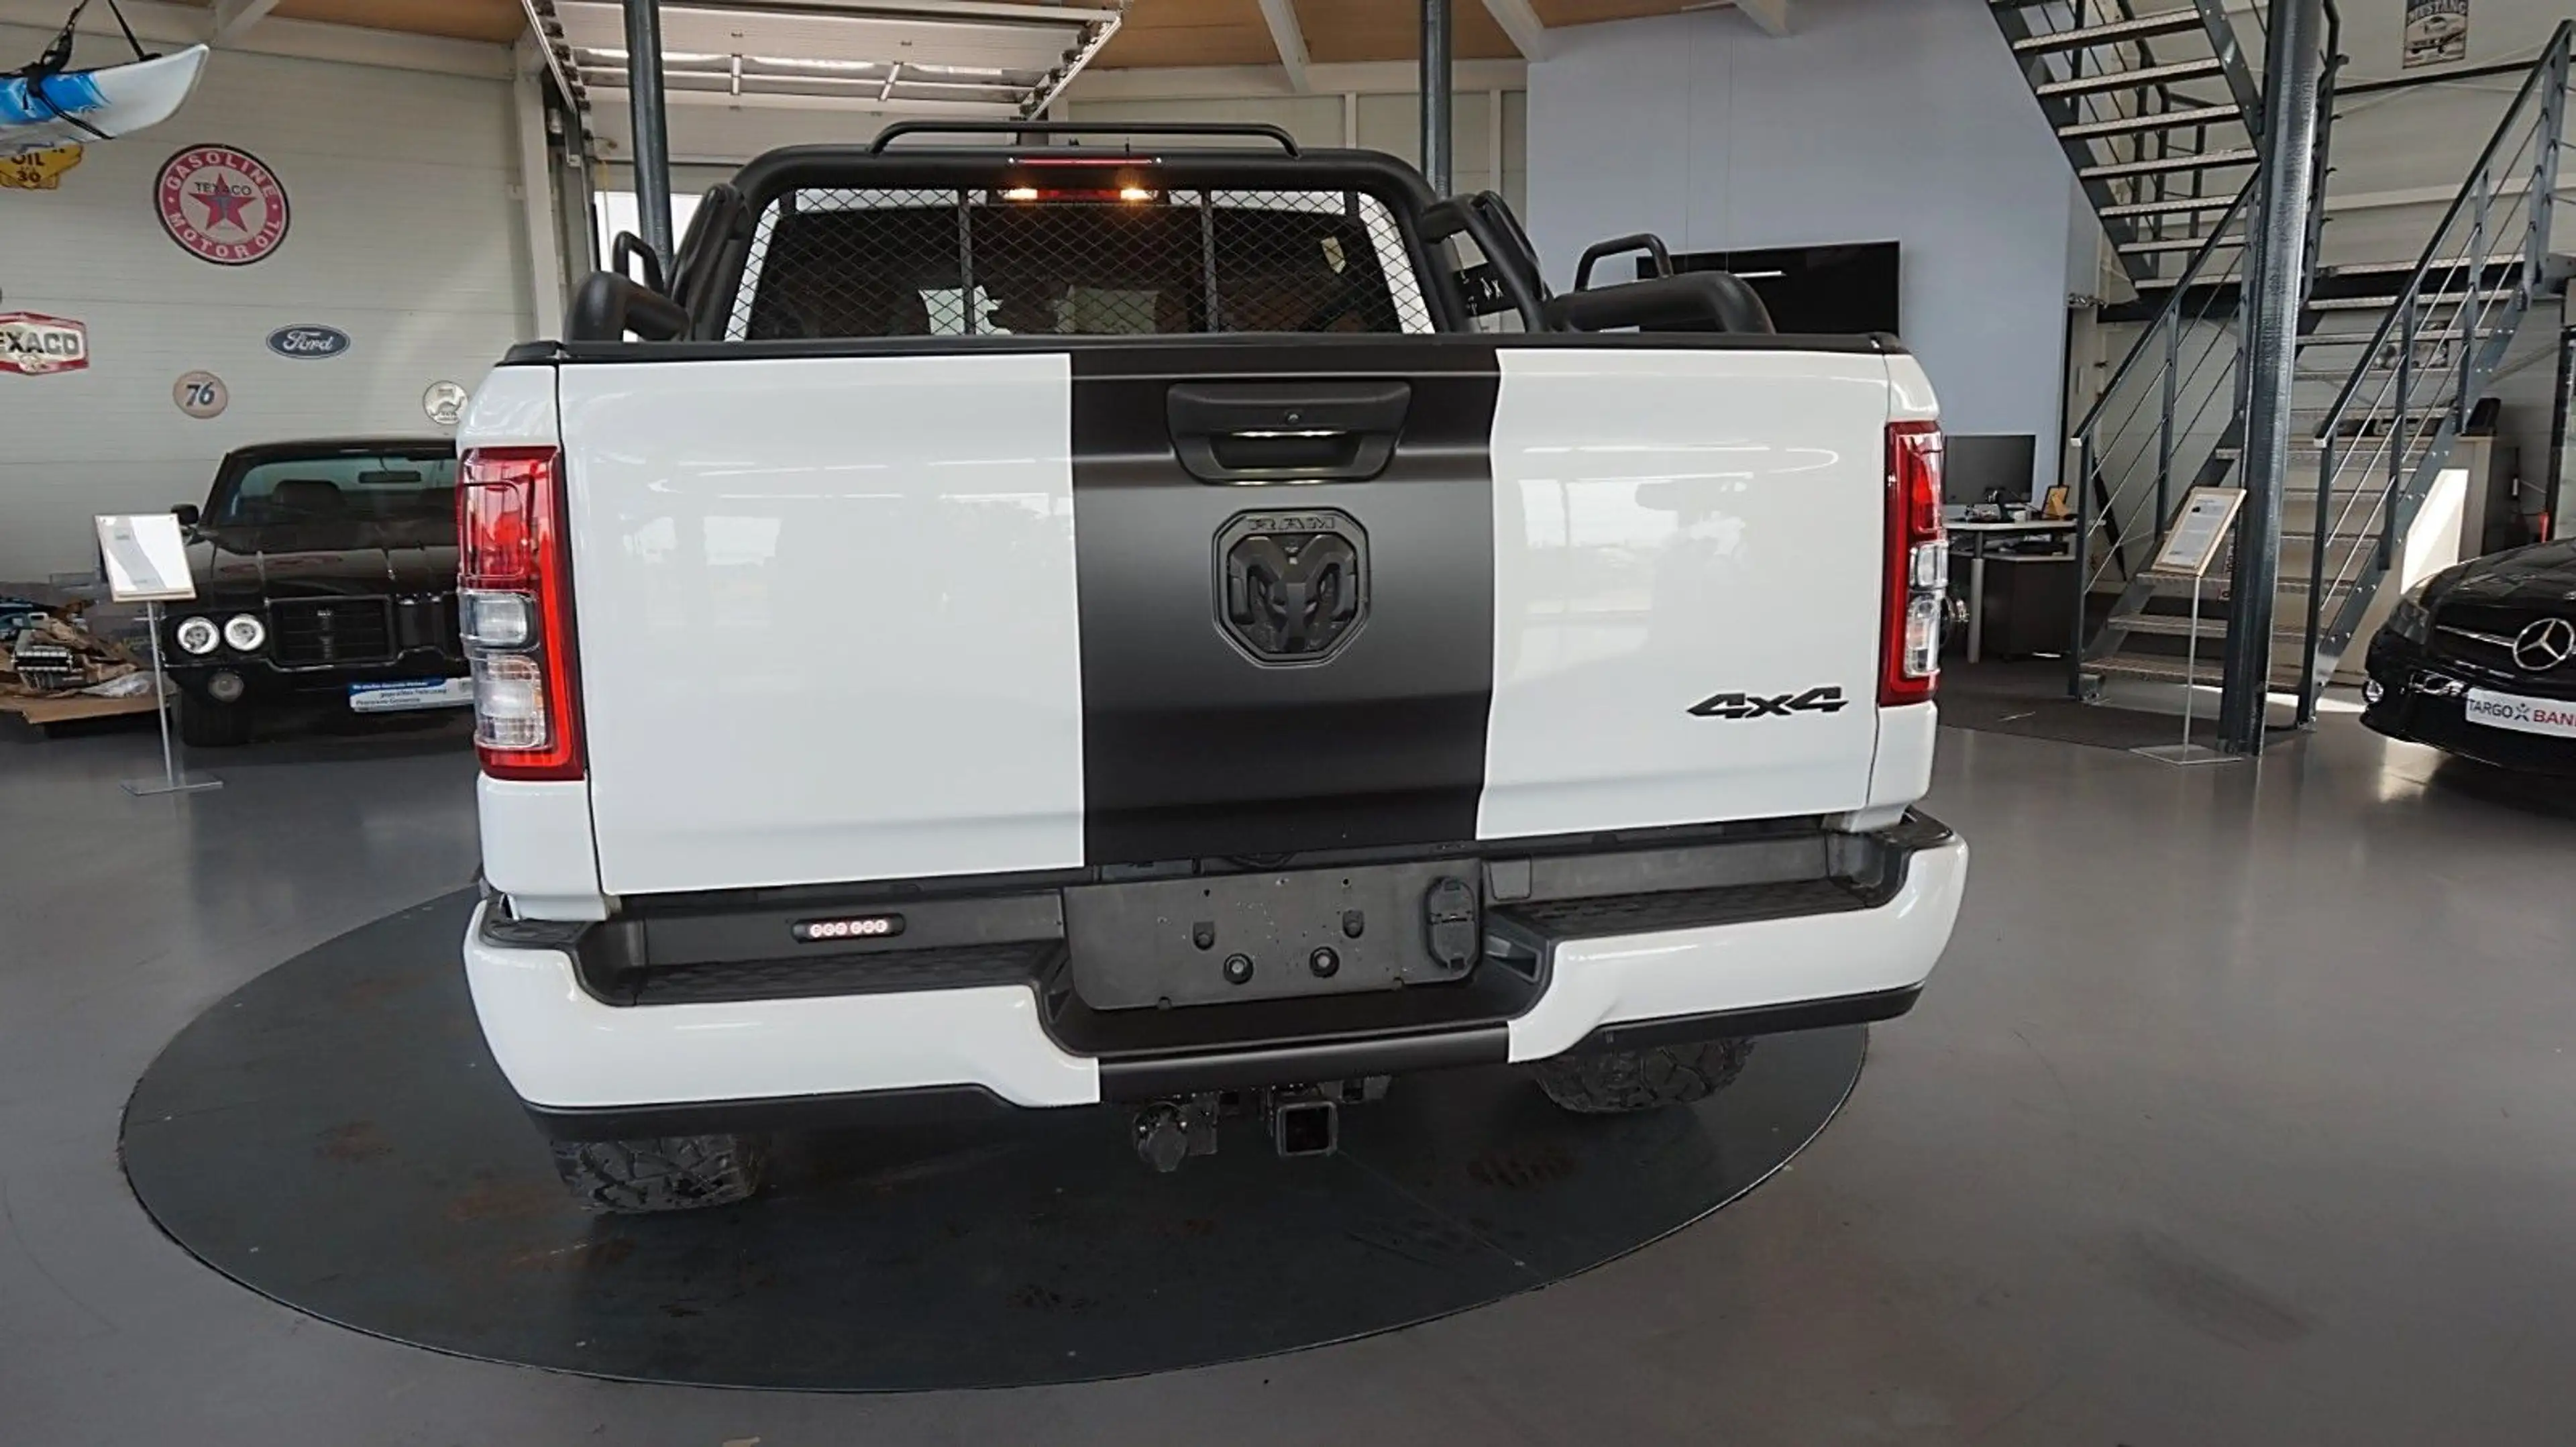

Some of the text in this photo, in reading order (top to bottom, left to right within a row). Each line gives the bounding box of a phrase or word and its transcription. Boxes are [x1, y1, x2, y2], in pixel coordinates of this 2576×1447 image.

[166, 152, 278, 197] GASOLINE
[169, 213, 280, 259] MOTOR OIL
[283, 329, 334, 351] Ford
[186, 381, 215, 407] 76
[1246, 515, 1336, 531] RAM
[2532, 709, 2576, 727] BAN
